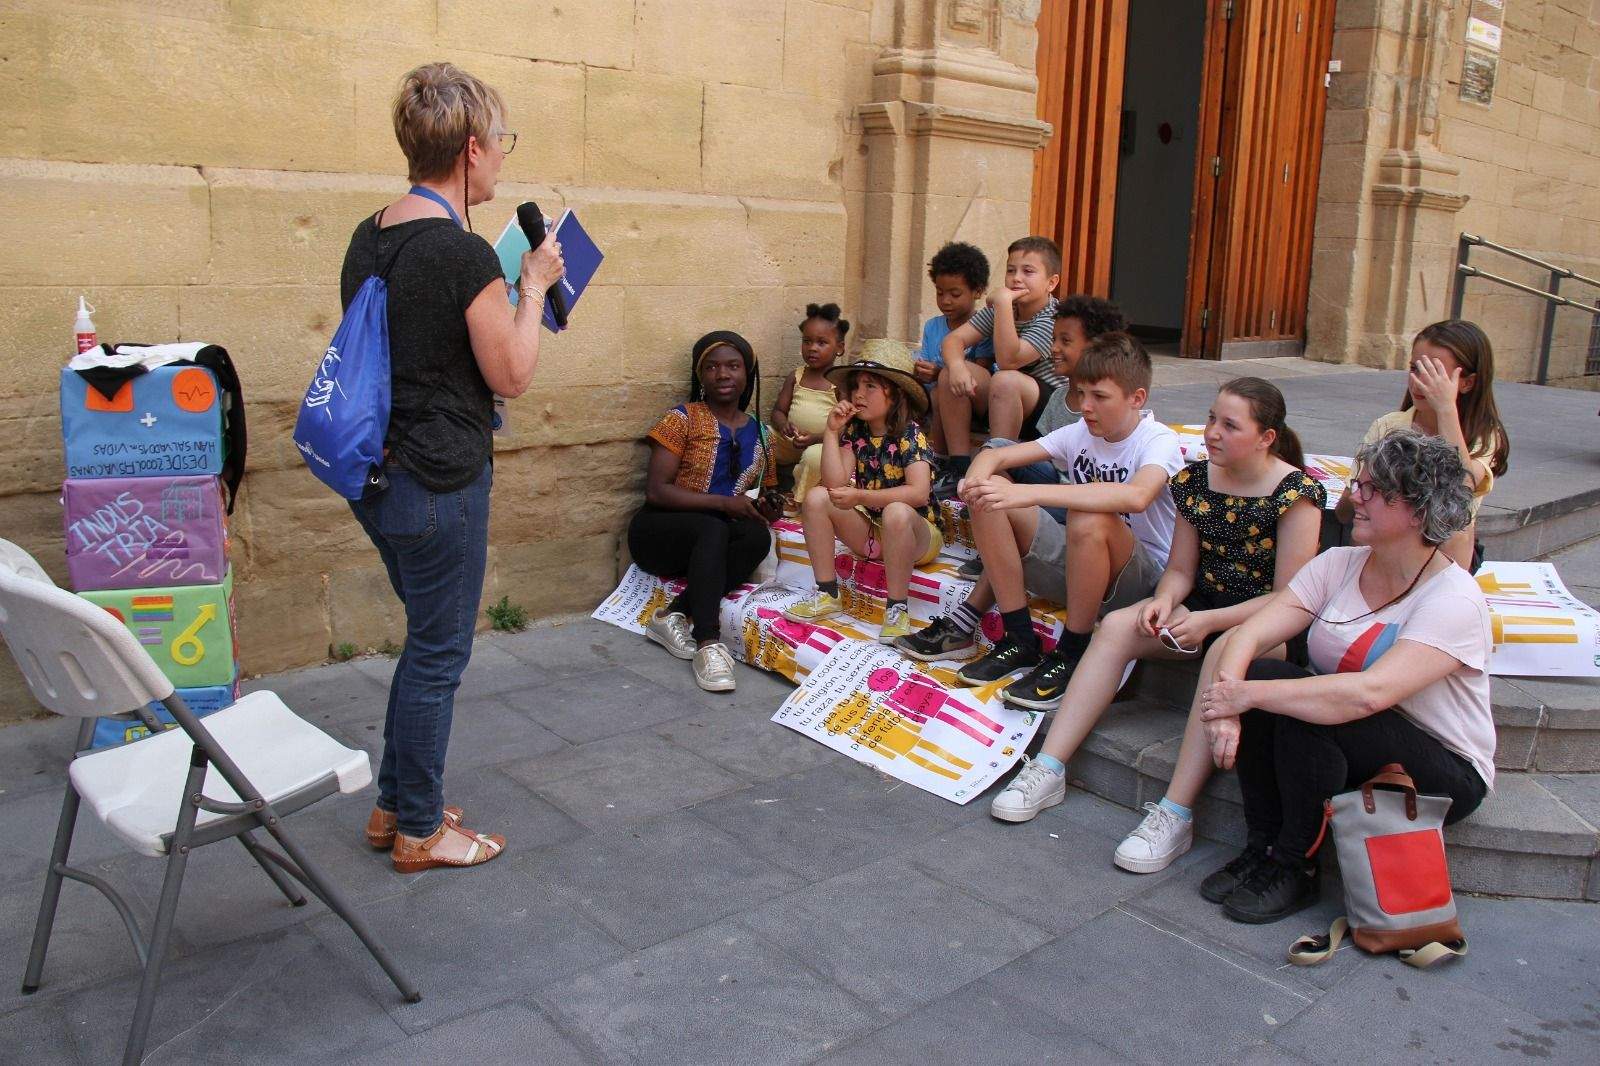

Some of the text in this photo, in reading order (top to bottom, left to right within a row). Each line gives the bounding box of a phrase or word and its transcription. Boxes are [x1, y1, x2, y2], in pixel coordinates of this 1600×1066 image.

[93, 442, 128, 455] VIDAS
[165, 454, 208, 470] DESDE
[193, 441, 215, 453] HAN
[71, 464, 117, 477] VACUNAS
[69, 491, 144, 552] INDUS
[95, 514, 169, 567] TRIA
[599, 606, 610, 616] da
[620, 585, 630, 594] tu
[779, 643, 851, 719] da tu color, tu
[793, 707, 805, 717] tu
[804, 675, 842, 706] religión,
[838, 661, 851, 672] tu
[827, 724, 842, 737] de
[840, 709, 858, 724] tus
[875, 670, 894, 685] los
[837, 698, 850, 708] tu
[850, 659, 889, 698] peinado,
[799, 717, 812, 726] tu
[811, 697, 837, 716] raza,
[834, 684, 846, 694] tu
[844, 722, 863, 737] los
[860, 685, 901, 721] tatuajes,
[868, 735, 883, 748] de
